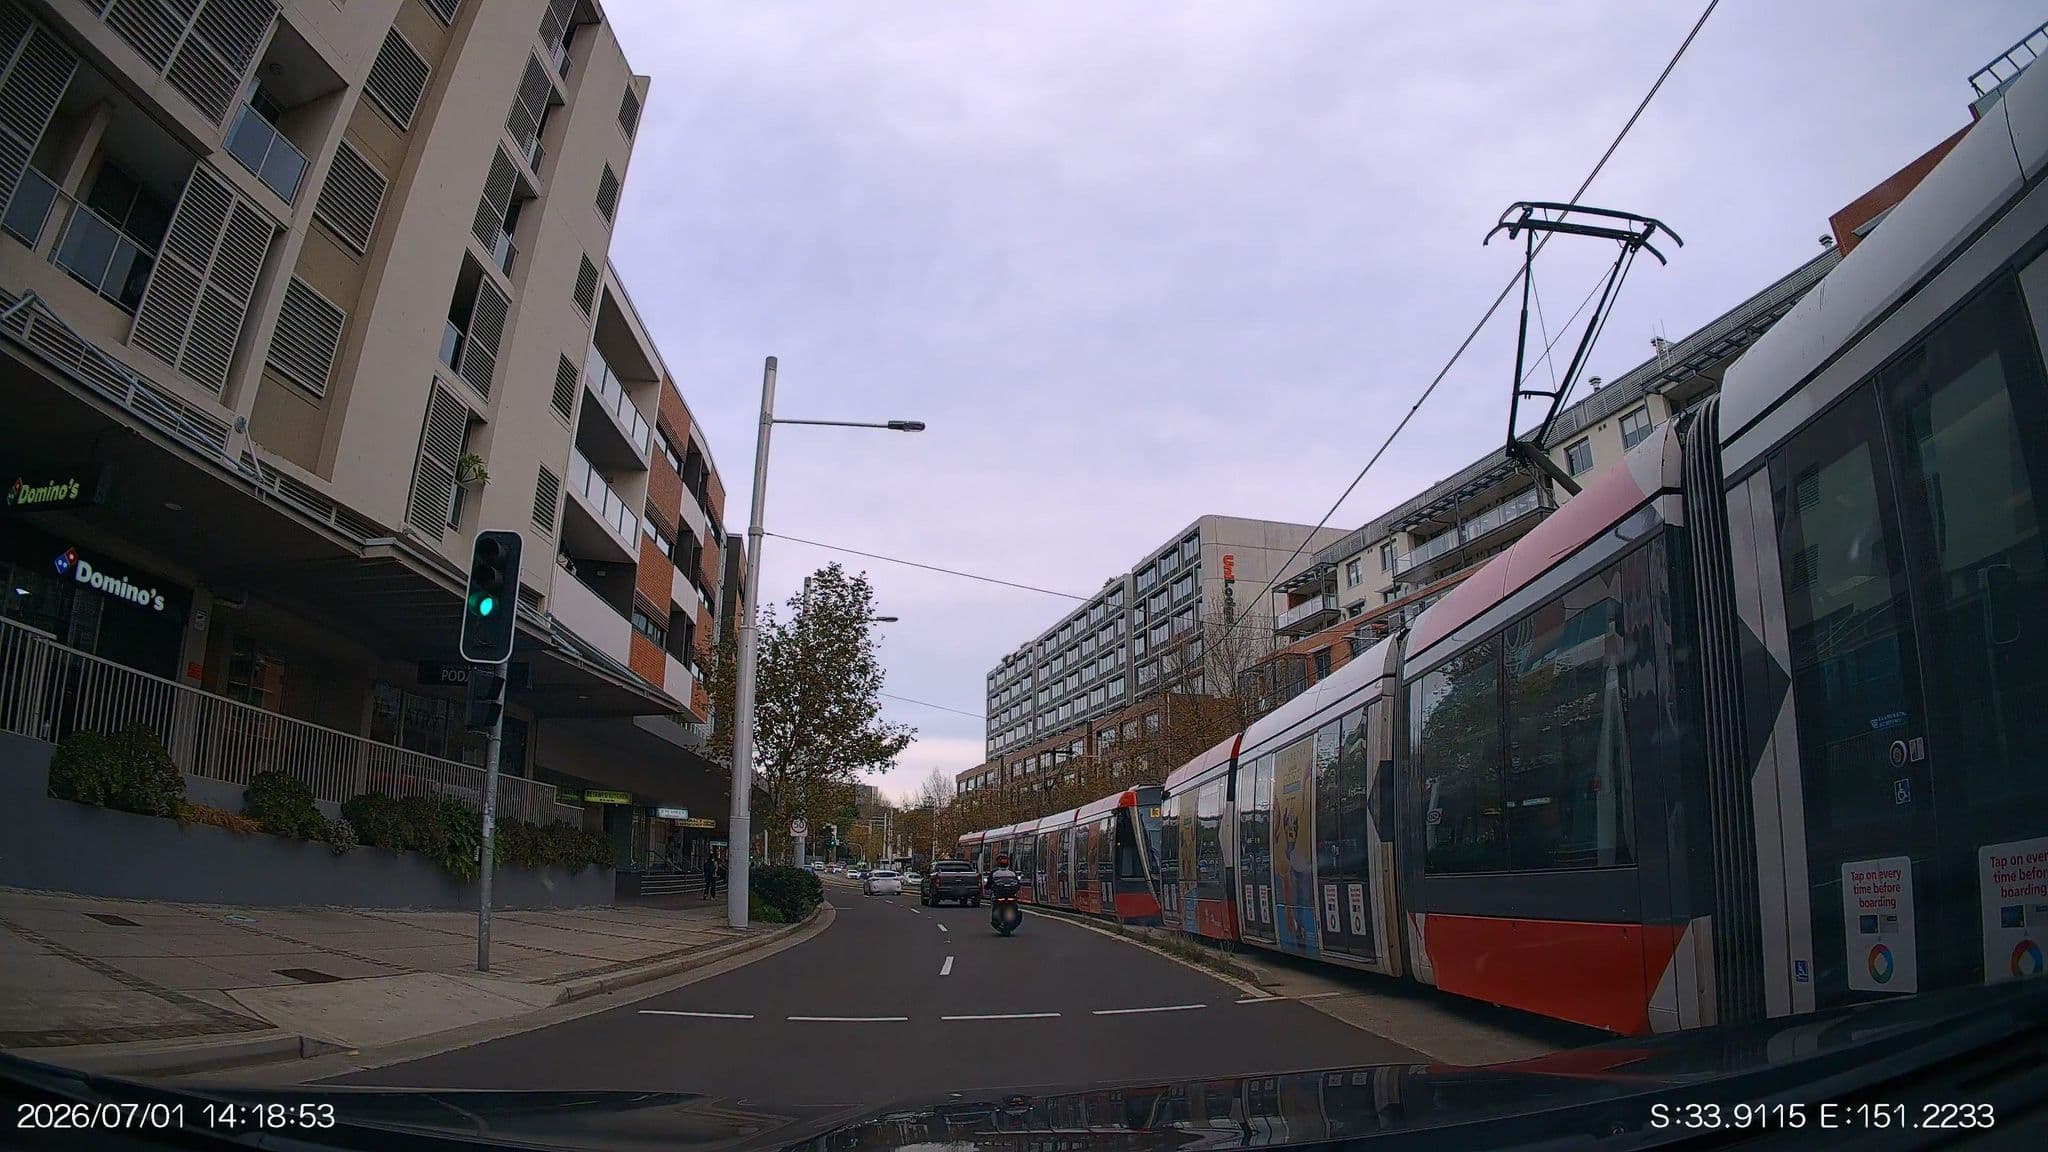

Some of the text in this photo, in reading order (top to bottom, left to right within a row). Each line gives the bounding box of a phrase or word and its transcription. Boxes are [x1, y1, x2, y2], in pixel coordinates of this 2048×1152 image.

[18, 478, 80, 504] Domino's
[75, 560, 165, 611] Domino's
[1150, 807, 1160, 818] L3
[1990, 856, 2007, 869] Tap
[2010, 855, 2023, 865] on
[1850, 869, 1901, 883] Tap on every
[1993, 871, 2016, 883] time
[1854, 882, 1901, 894] time before
[2000, 884, 2048, 898] boarding
[1859, 896, 1896, 909] boarding
